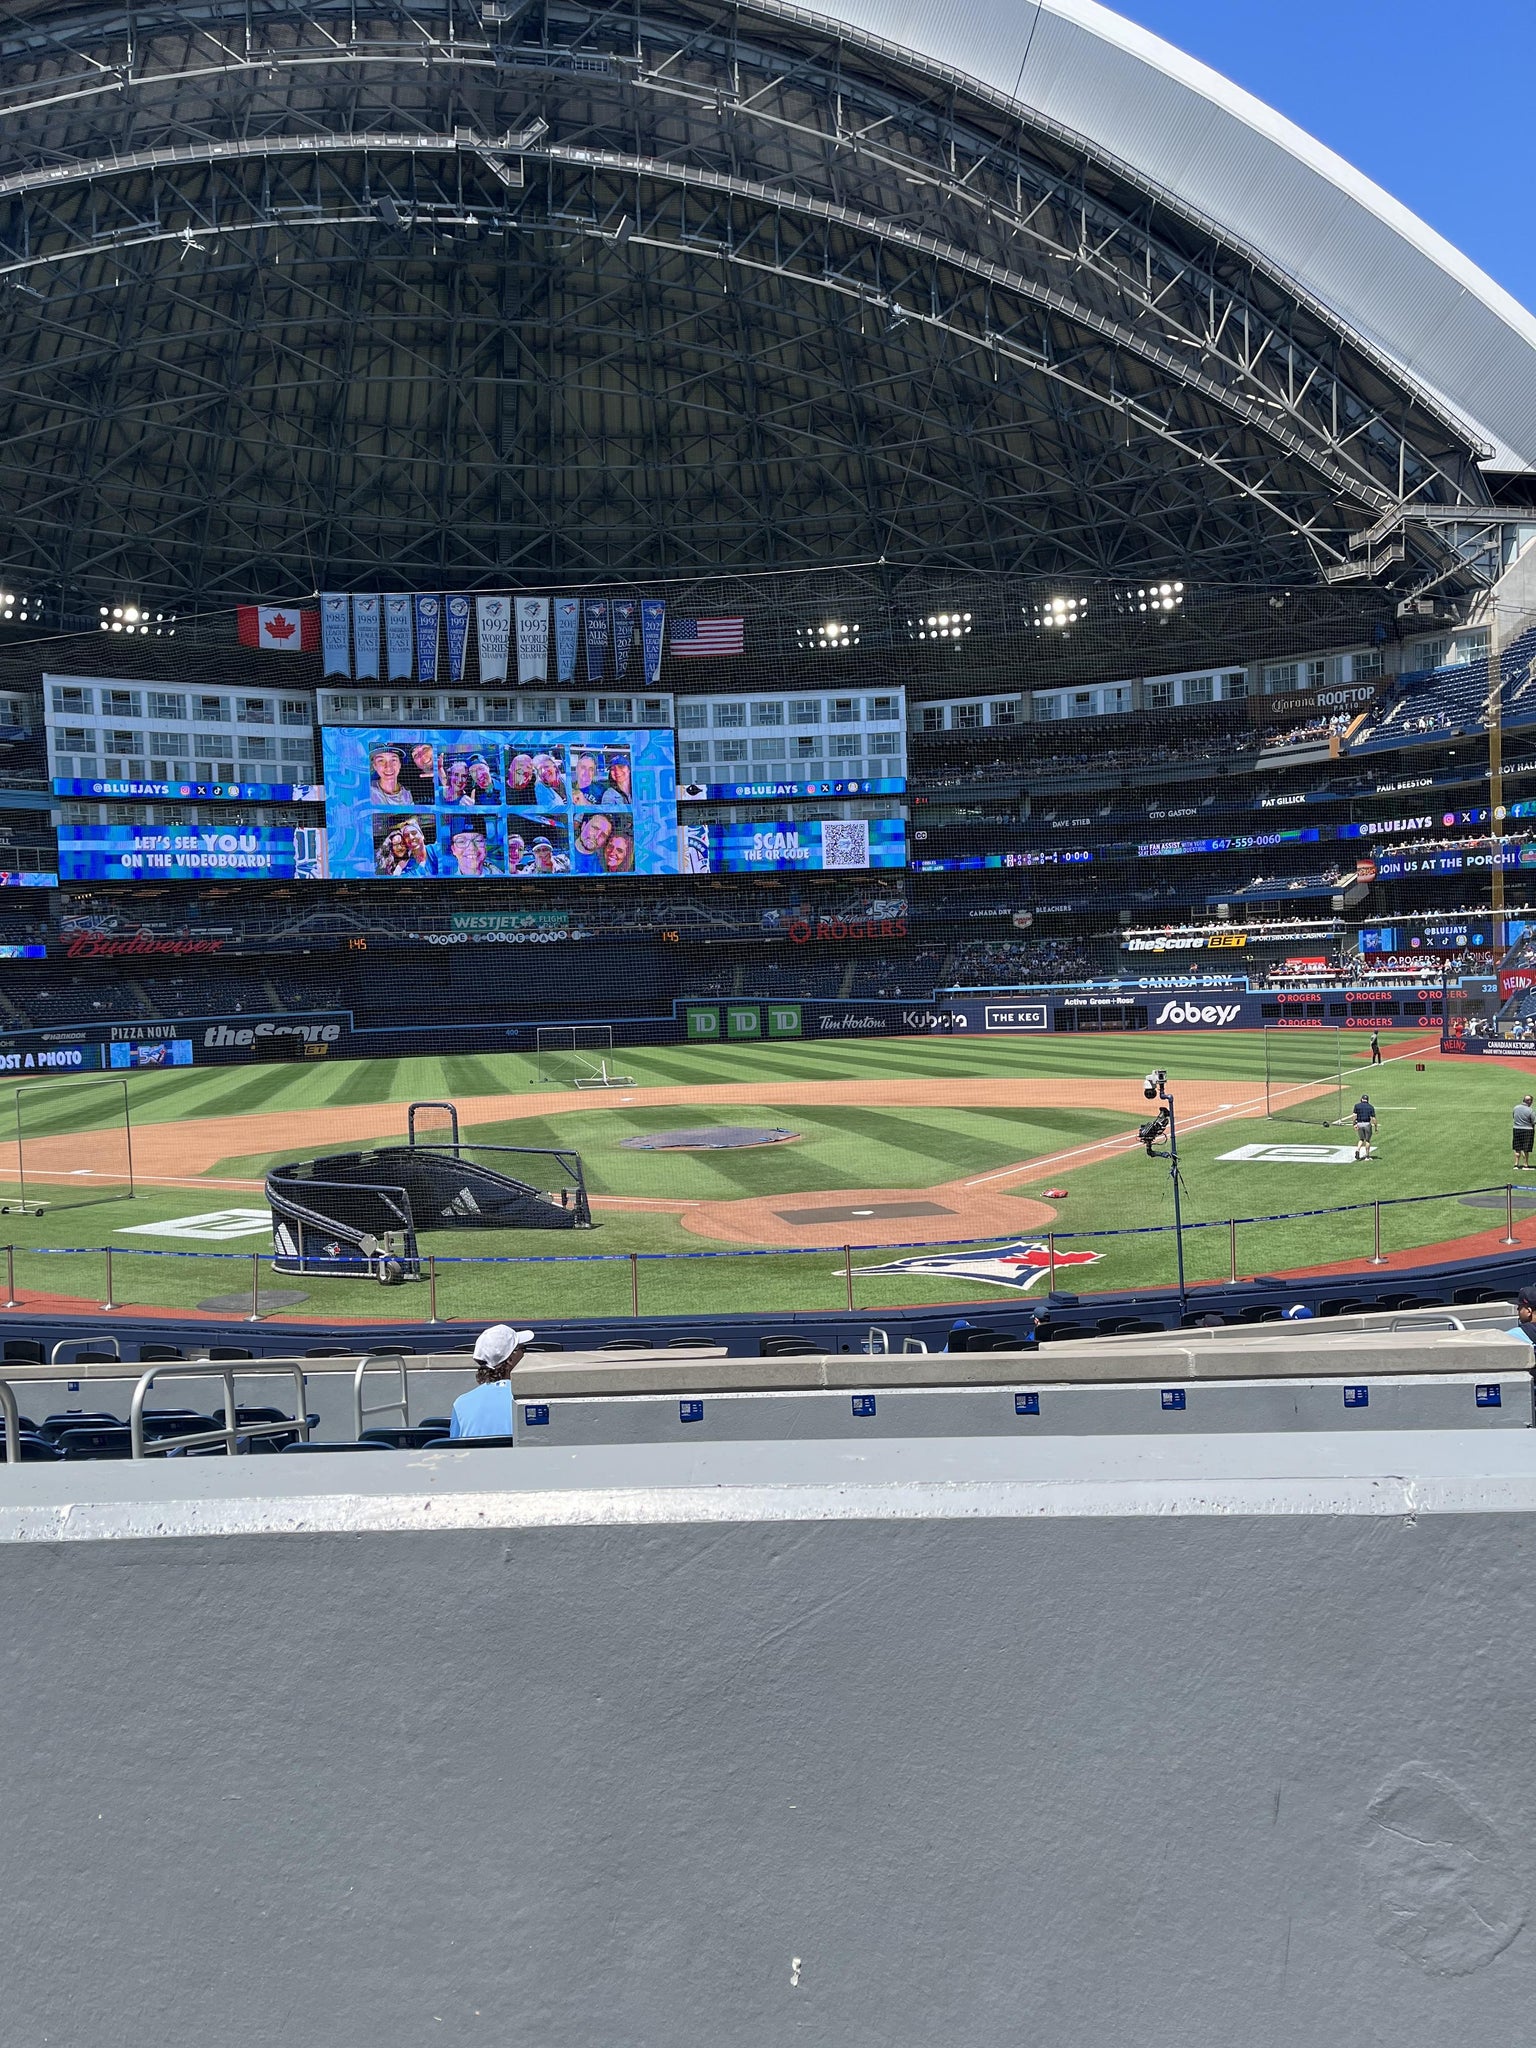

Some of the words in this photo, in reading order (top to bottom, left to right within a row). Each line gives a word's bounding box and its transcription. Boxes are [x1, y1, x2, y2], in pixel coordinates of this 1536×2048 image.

[326, 614, 346, 622] 1985
[357, 616, 378, 624] 1989
[390, 616, 408, 625] 1991
[451, 618, 464, 626] 199
[481, 619, 508, 631] 1992
[521, 620, 547, 632] 1993
[588, 621, 606, 629] 2016
[481, 634, 509, 643] WORLD
[520, 635, 547, 643] WORLD
[481, 643, 509, 652] SERIES
[520, 644, 548, 652] SERIES
[1272, 698, 1315, 713] Corona
[1317, 686, 1375, 706] ROOFTOP
[1334, 702, 1358, 711] PATIO
[1498, 764, 1515, 774] ROY
[93, 783, 169, 794] @BLUEJAYS
[736, 785, 798, 795] @BLUEJAYS
[1376, 784, 1395, 793] PAUL
[1397, 778, 1433, 790] BEESTON
[1262, 799, 1277, 807] PAT
[1278, 795, 1305, 806] GILLICK
[1149, 811, 1165, 819] CITO
[1168, 808, 1197, 817] GASTON
[1052, 820, 1069, 828] DAVE
[1072, 818, 1090, 826] STIEB
[1359, 816, 1433, 835] @BLUEJAYS
[135, 837, 170, 850] LET'S
[175, 837, 198, 849] SEE
[200, 834, 258, 853] YOU
[753, 832, 799, 850] SCAN
[1212, 834, 1281, 850] 647-559-0060
[121, 854, 143, 867] ON
[146, 854, 172, 867] THE
[174, 853, 272, 868] VIDEOBOARD!
[744, 849, 764, 861] THE
[765, 849, 780, 861] QR
[782, 849, 810, 861] CODE
[1379, 863, 1401, 874] JOIN
[1404, 861, 1418, 872] US
[1421, 860, 1436, 870] AT
[1440, 857, 1463, 869] THE
[1466, 854, 1515, 867] PORCH!
[969, 909, 997, 917] CANADA
[1036, 905, 1072, 913] BLEACHERS
[454, 916, 521, 930] WESTJET
[539, 915, 567, 923] FLIGHT
[817, 919, 907, 939] ROGERS
[1424, 926, 1467, 935] @BLUEJAYS
[430, 933, 466, 944] VOTE
[488, 932, 524, 942] BLUE
[532, 931, 566, 942] JAYS
[1128, 937, 1204, 951] theScore
[1210, 936, 1247, 947] BET
[60, 930, 224, 958] Budweiser
[1138, 976, 1198, 989] CANADA
[1503, 975, 1532, 990] HEINZ
[1482, 985, 1498, 993] 328
[1064, 998, 1088, 1006] Active
[1090, 997, 1134, 1005] Green+Ross
[1287, 993, 1321, 1002] ROGERS
[1356, 992, 1392, 1000] ROGERS
[993, 1013, 1014, 1022] THE
[1018, 1012, 1040, 1022] KEG
[1156, 1001, 1241, 1025] Sobeys
[690, 1014, 716, 1032] TD
[731, 1012, 757, 1032] TD
[772, 1011, 798, 1030] TD
[819, 1015, 842, 1029] Tim
[843, 1014, 886, 1029] Hortons
[1287, 1018, 1322, 1026] ROGERS
[1356, 1018, 1393, 1026] ROGERS
[111, 1027, 144, 1041] PIZZA
[147, 1025, 177, 1039] NOVA
[304, 1044, 328, 1055] ET
[1443, 1040, 1467, 1051] HEINZ
[1488, 1041, 1513, 1049] CANADIAN
[0, 1054, 21, 1070] OST
[24, 1053, 35, 1068] A
[38, 1051, 82, 1067] PHOTO
